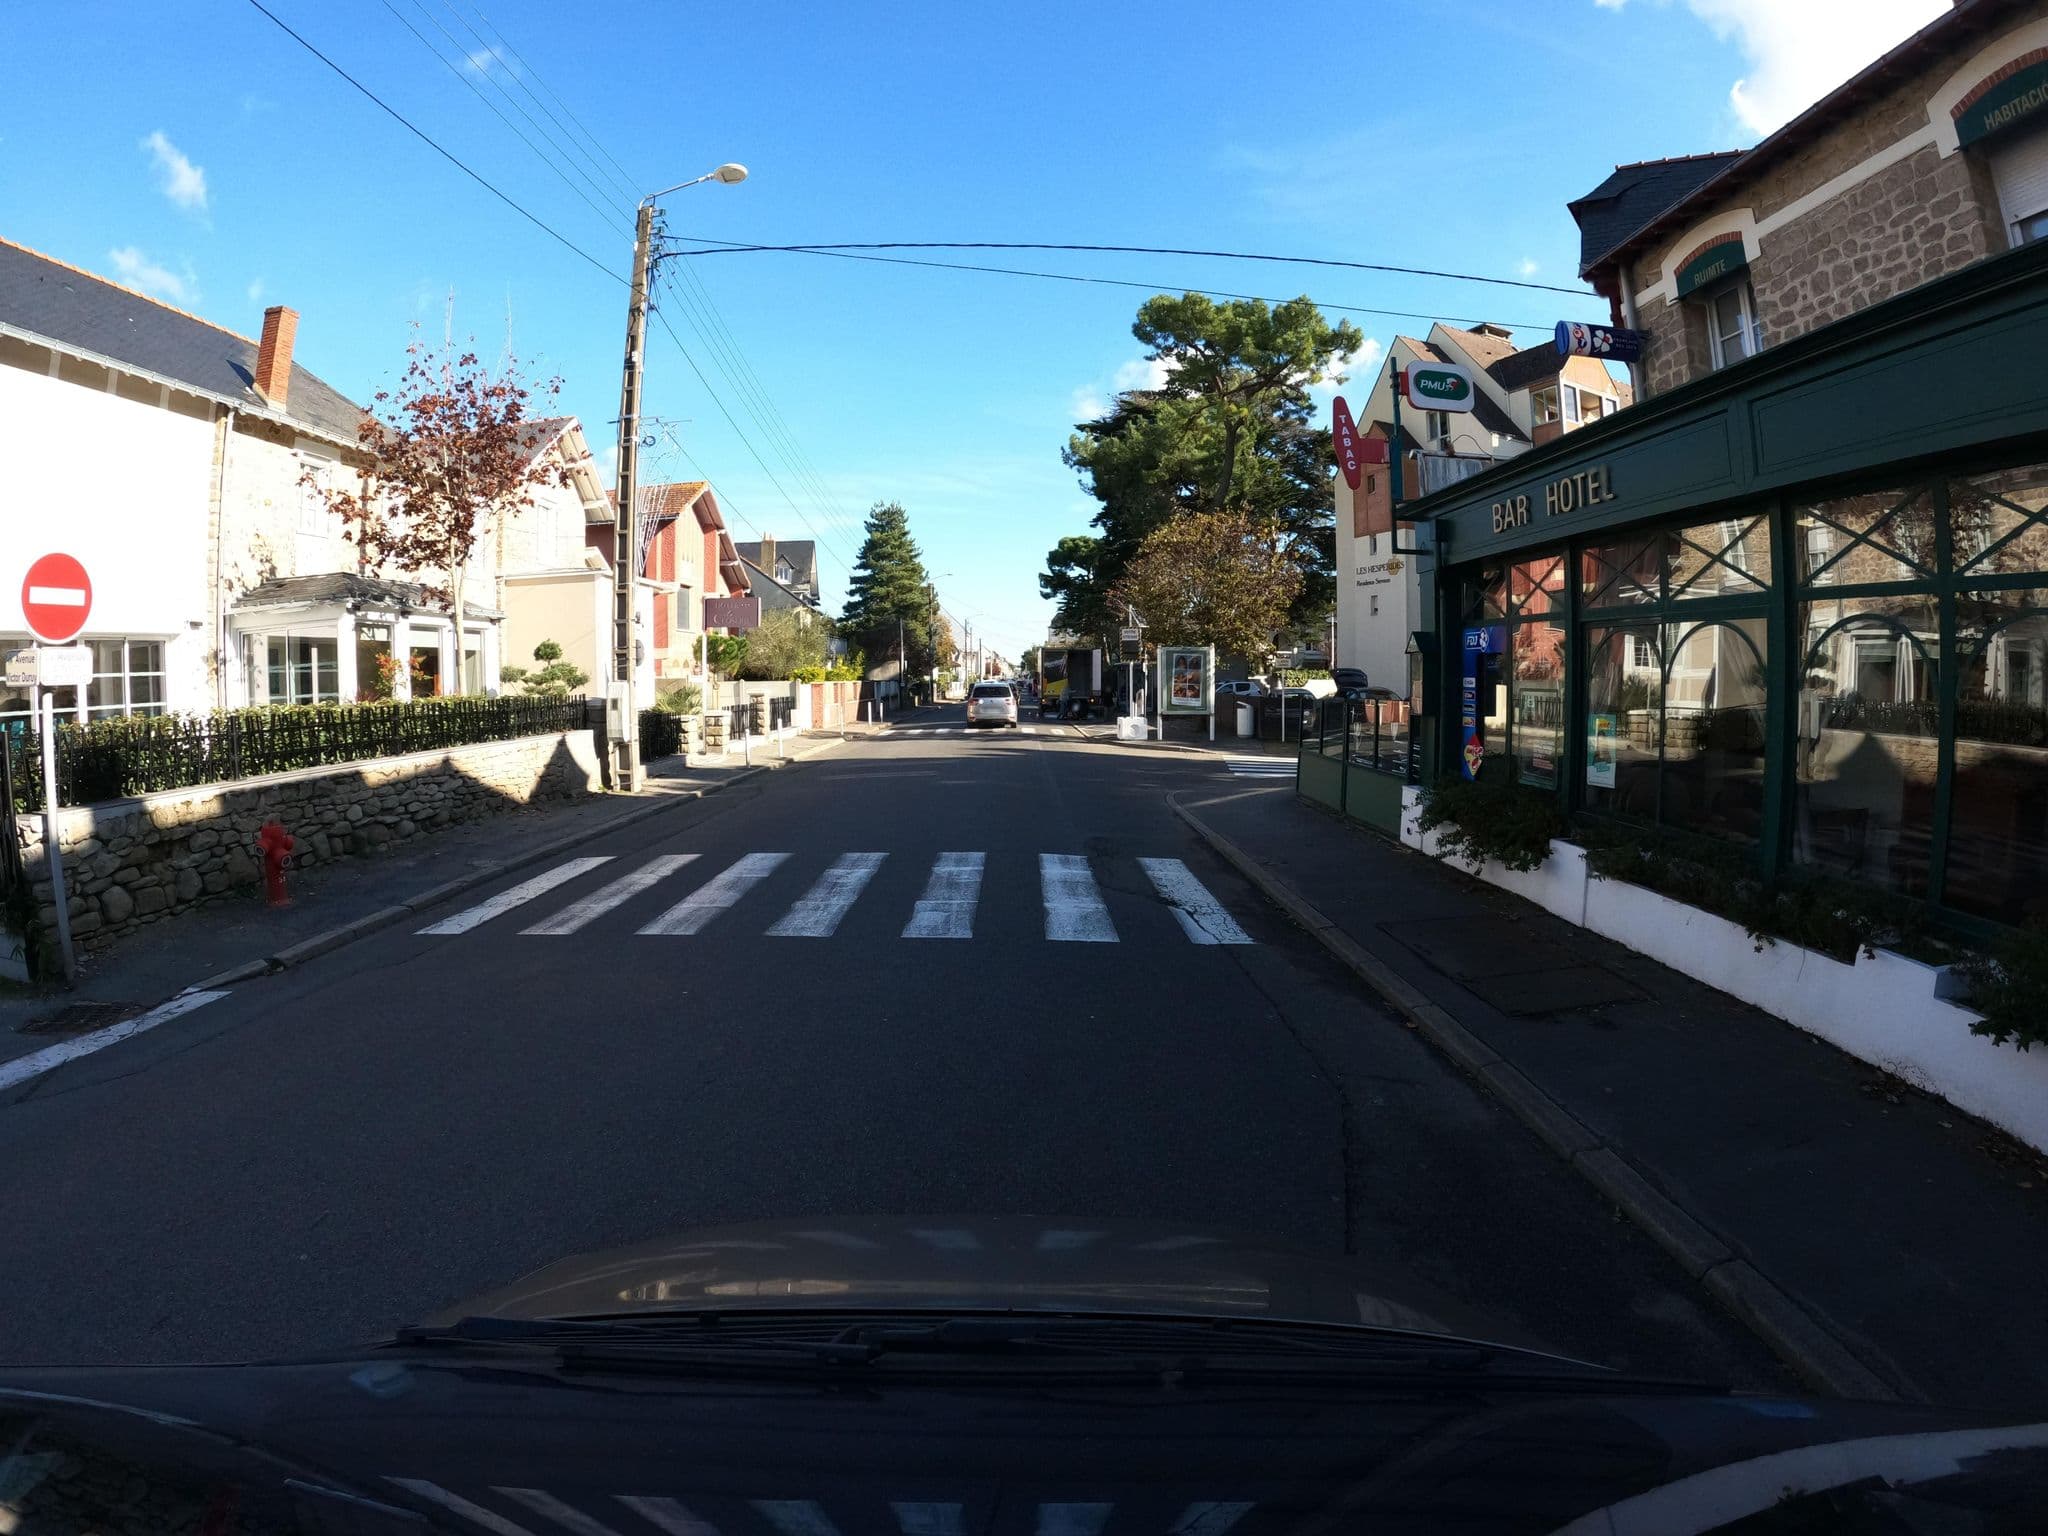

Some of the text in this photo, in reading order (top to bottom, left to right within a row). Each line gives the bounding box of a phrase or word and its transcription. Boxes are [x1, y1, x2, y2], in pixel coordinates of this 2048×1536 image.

[1420, 379, 1446, 391] PMU
[1338, 414, 1357, 471] TABAC
[1492, 465, 1615, 534] BAR HOTEL
[1356, 567, 1367, 575] LES
[15, 655, 35, 664] Avenue
